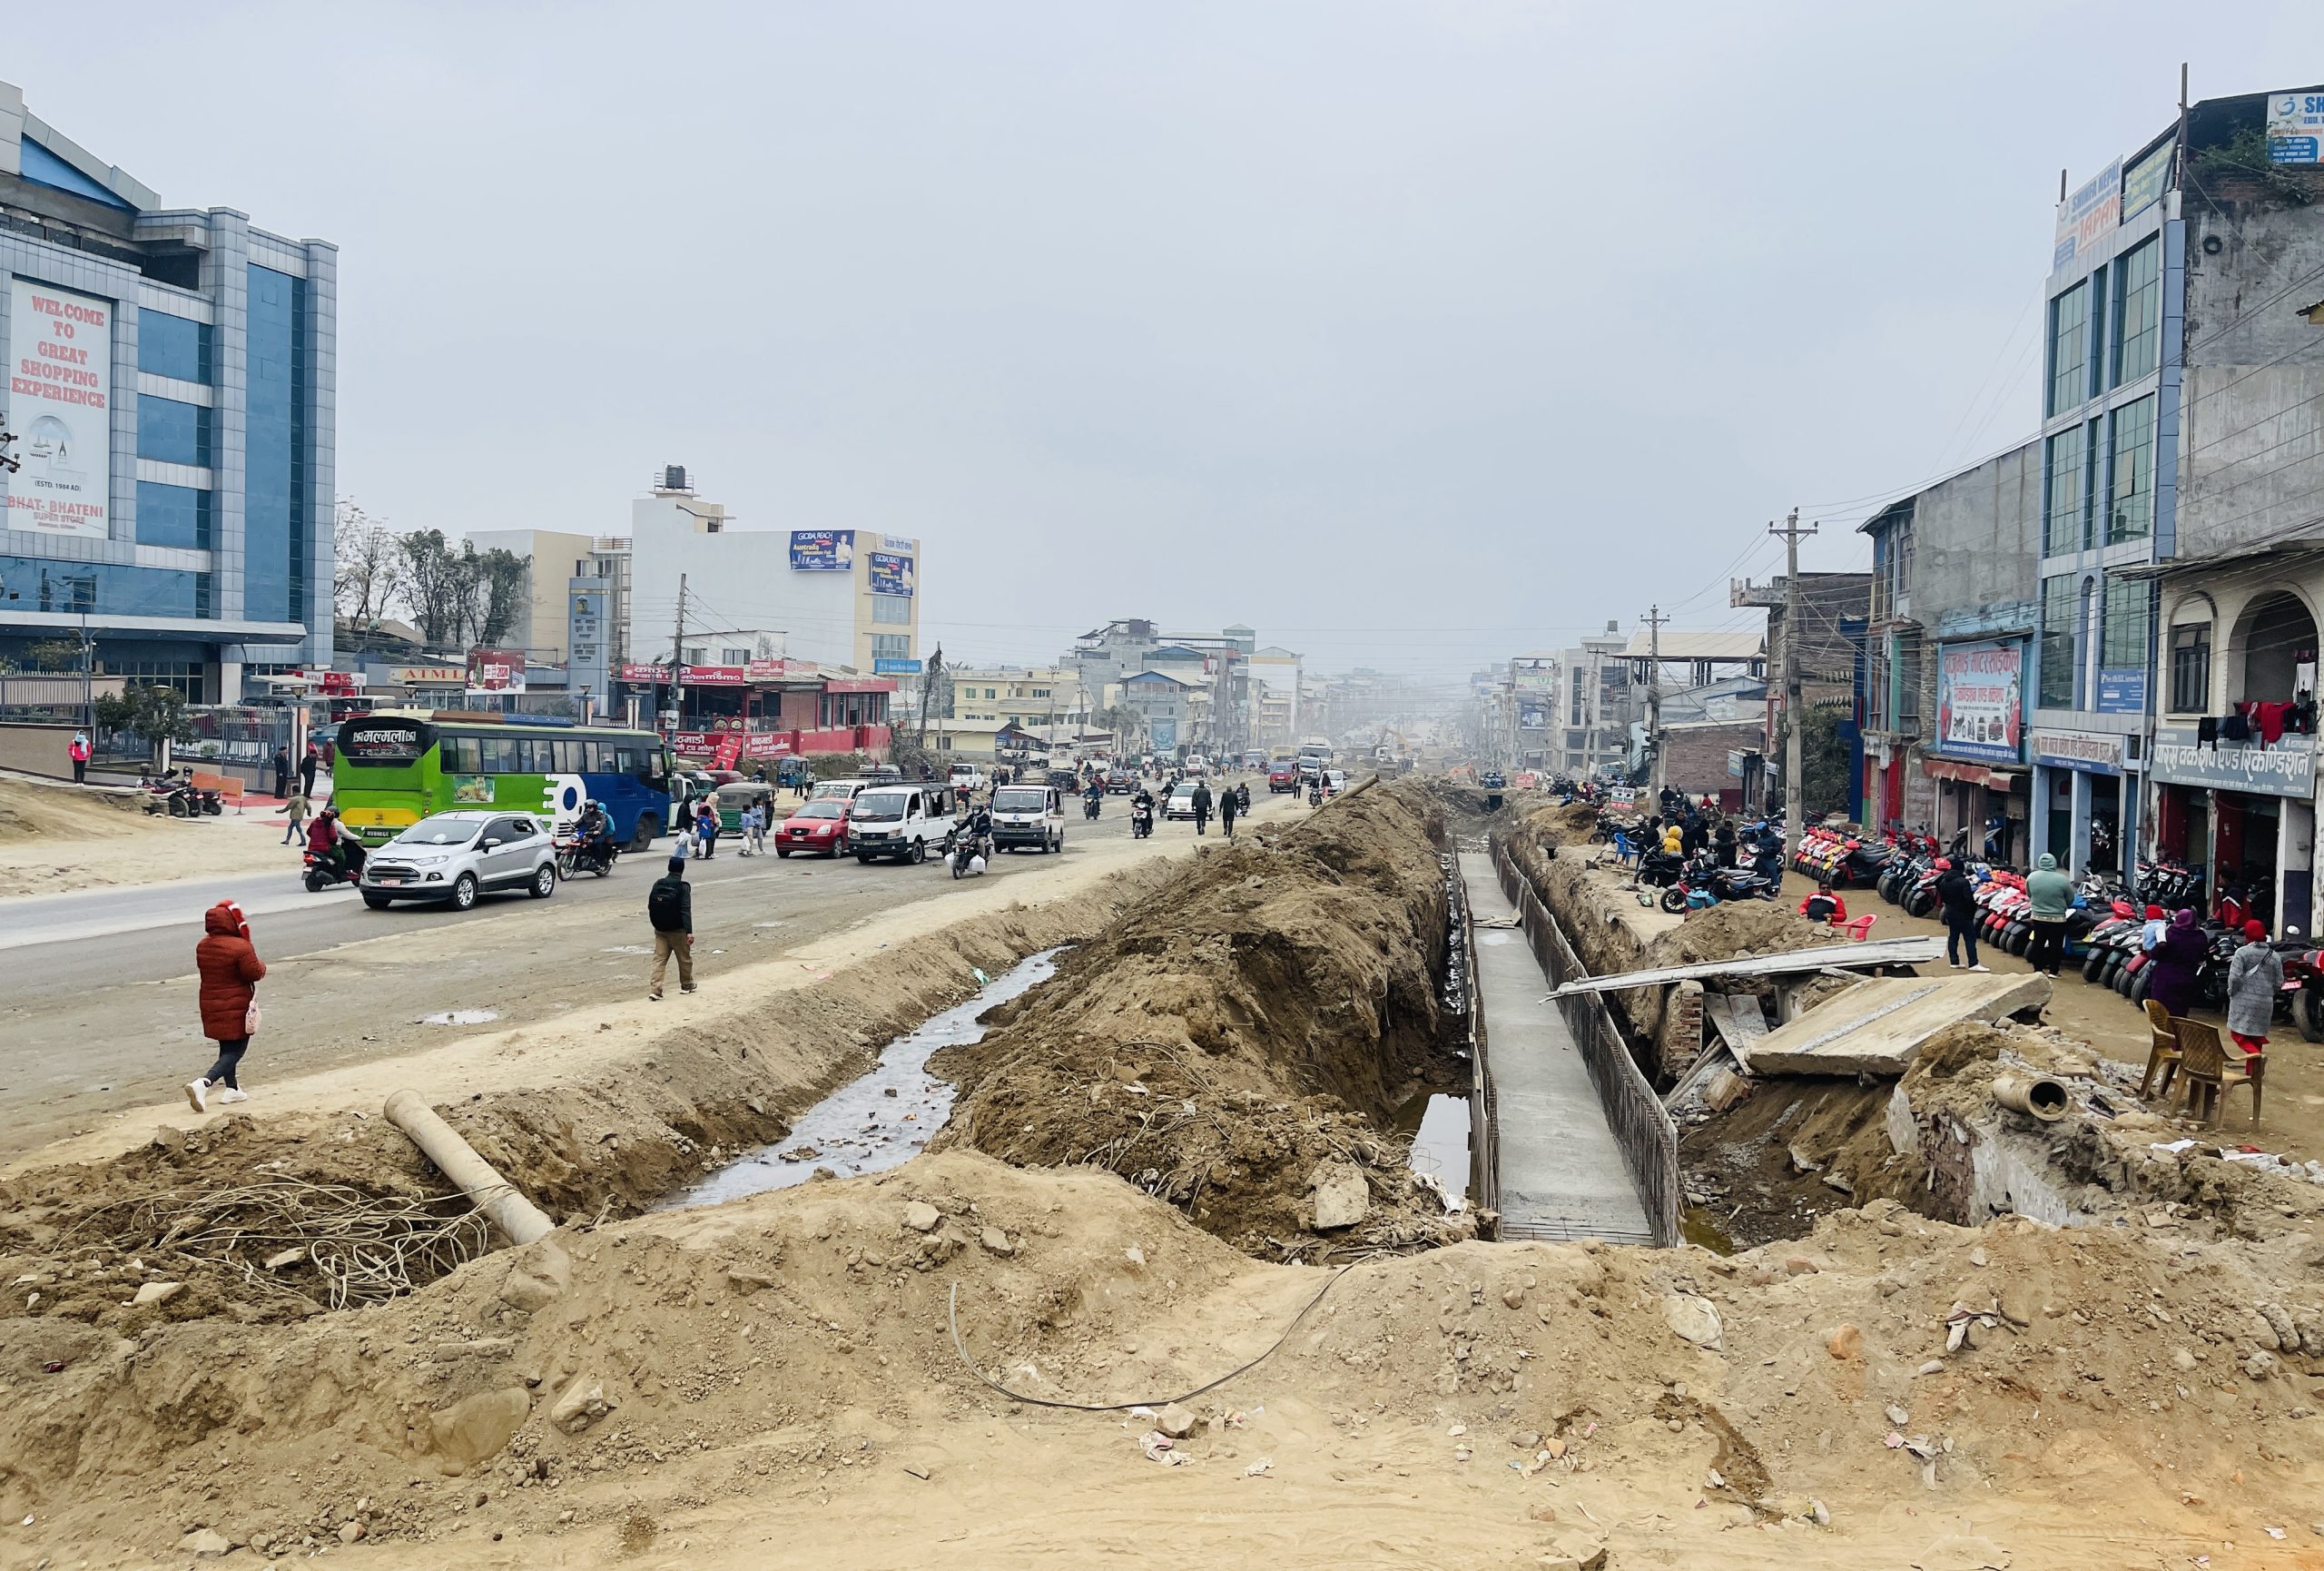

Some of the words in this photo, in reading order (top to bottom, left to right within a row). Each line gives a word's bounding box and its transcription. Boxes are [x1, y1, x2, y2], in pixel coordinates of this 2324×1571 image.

[2305, 95, 2324, 114] SH
[2098, 161, 2120, 194] NEPAL
[2077, 193, 2120, 251] JAPAN
[32, 295, 104, 327] WELCOME
[54, 321, 74, 339] TO
[38, 341, 88, 365] GREAT
[21, 359, 98, 388] SHOPPING
[11, 377, 105, 409] EXPERIENCE
[34, 511, 59, 523] SUPER
[60, 514, 85, 524] STORE
[49, 500, 103, 518] BHATENI
[816, 531, 833, 540] REACH
[405, 668, 447, 679] ATM
